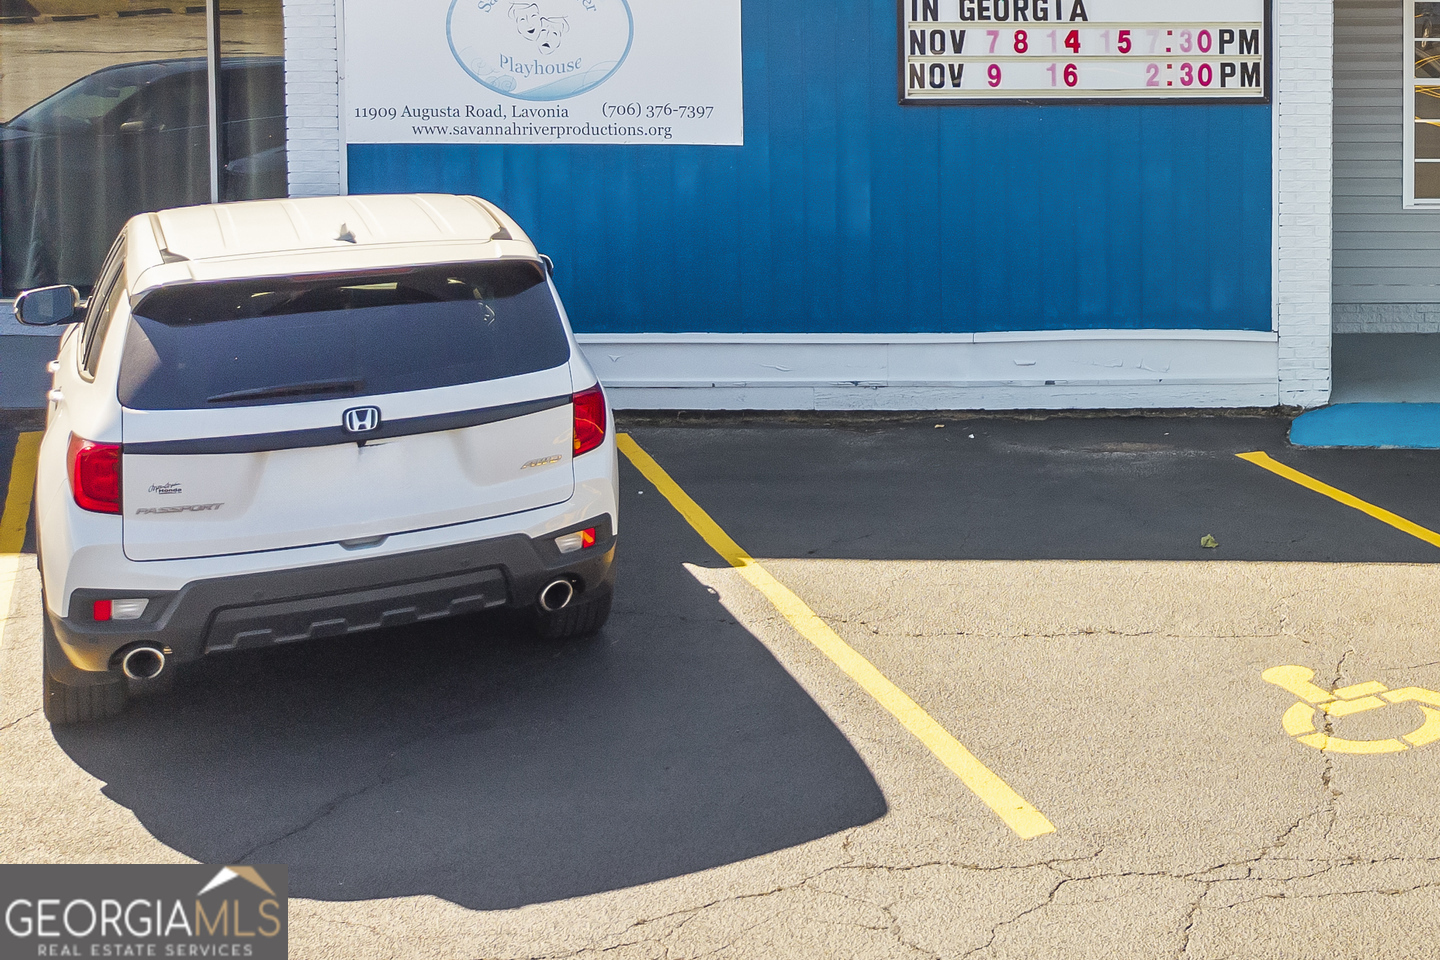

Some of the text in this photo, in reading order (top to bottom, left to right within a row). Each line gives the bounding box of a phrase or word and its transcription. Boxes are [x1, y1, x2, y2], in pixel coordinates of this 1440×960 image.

[909, 29, 967, 55] NOV
[499, 52, 583, 78] Playhouse
[909, 62, 965, 88] NOV
[986, 62, 1003, 87] 9
[354, 101, 715, 122] 11909 Augusta Road, Lavonia (706) 376-7397
[411, 121, 673, 139] www.savannahriverproductions.org
[135, 502, 225, 515] PASSPORT
